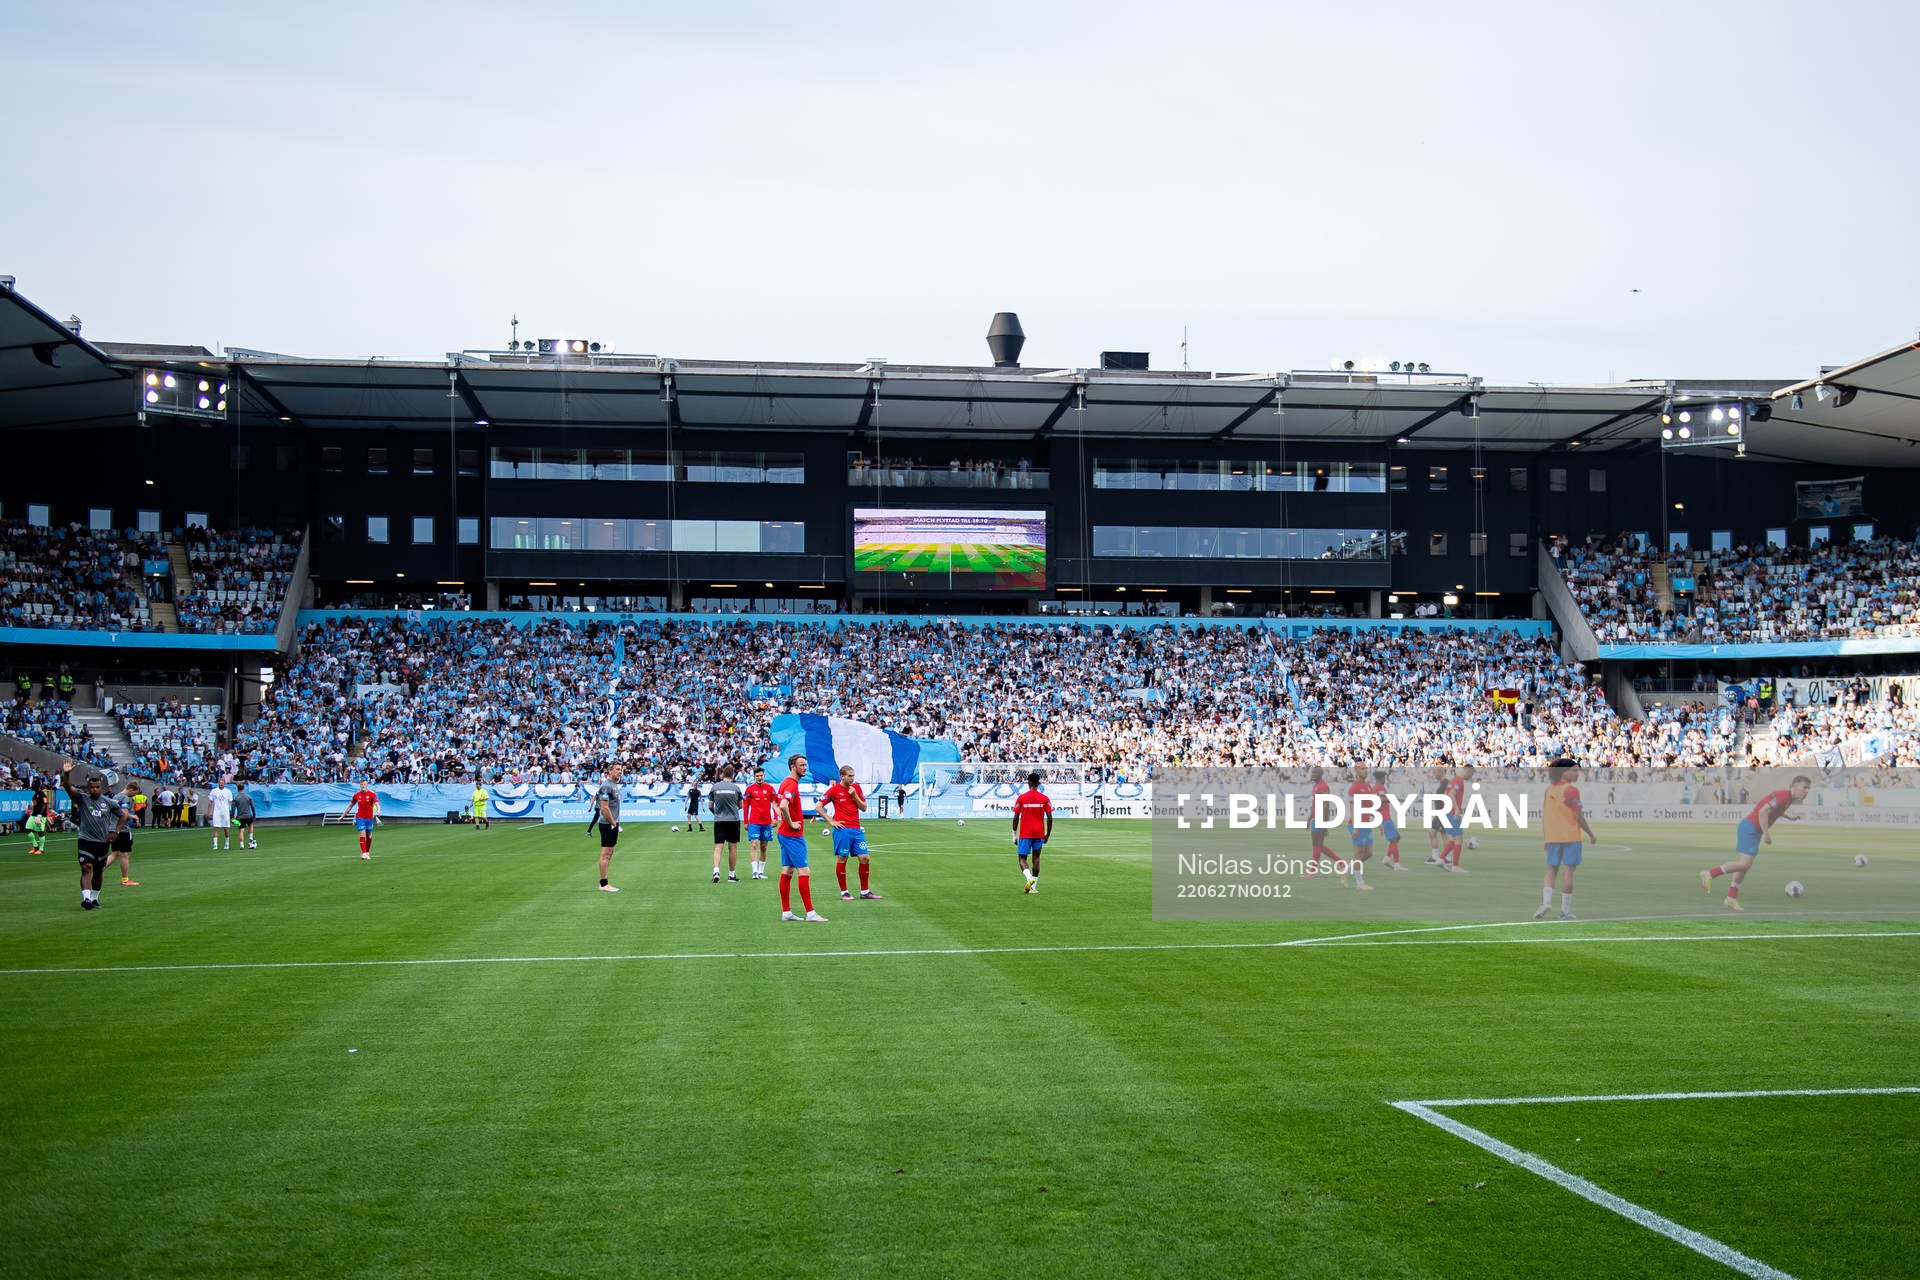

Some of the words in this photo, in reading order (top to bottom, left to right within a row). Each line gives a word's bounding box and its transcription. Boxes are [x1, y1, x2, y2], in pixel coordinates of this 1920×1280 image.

[1101, 802, 1131, 815] bemt
[1154, 804, 1184, 816] bemt
[1206, 806, 1230, 816] bem
[1615, 808, 1643, 818] bemt
[1665, 808, 1693, 818] bemt
